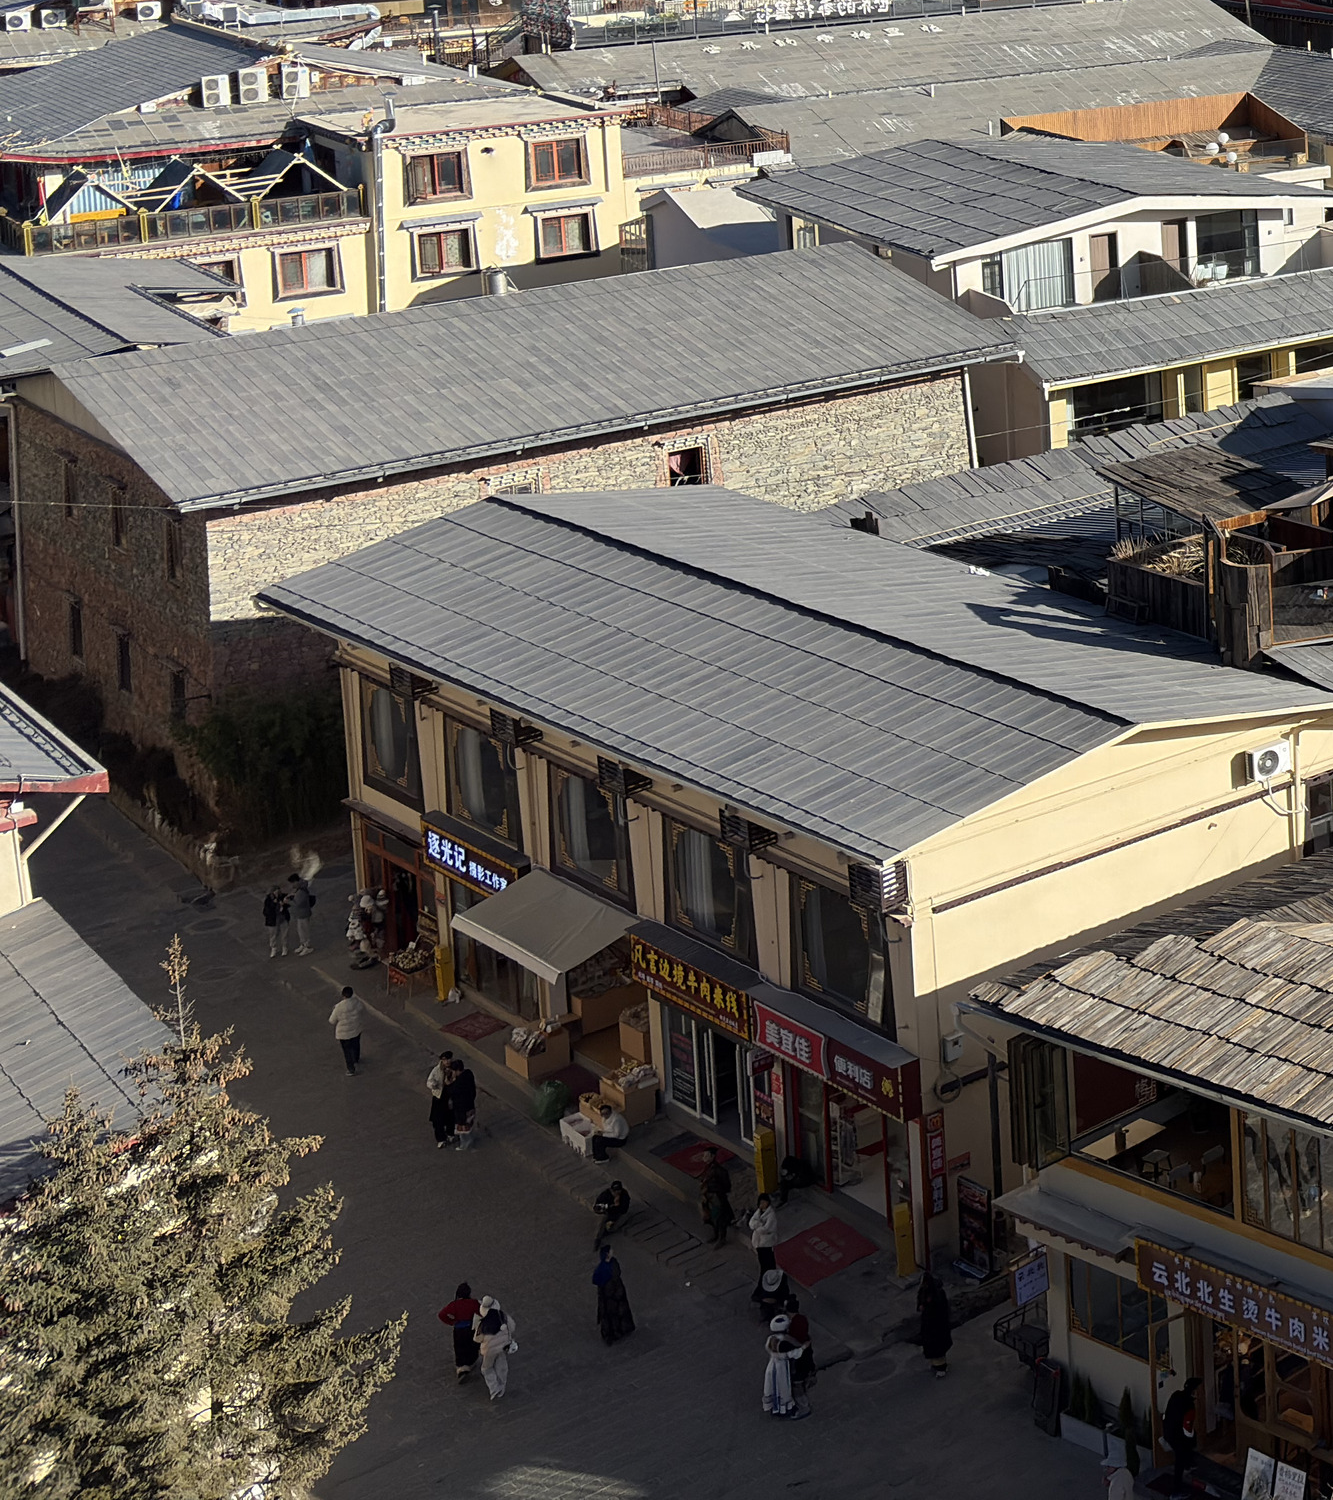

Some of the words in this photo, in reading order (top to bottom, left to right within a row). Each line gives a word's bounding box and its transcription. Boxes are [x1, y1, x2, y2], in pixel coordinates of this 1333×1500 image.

[428, 831, 466, 873] 逐光记
[765, 1019, 812, 1064] 美宜佳
[834, 1054, 874, 1090] 便利店
